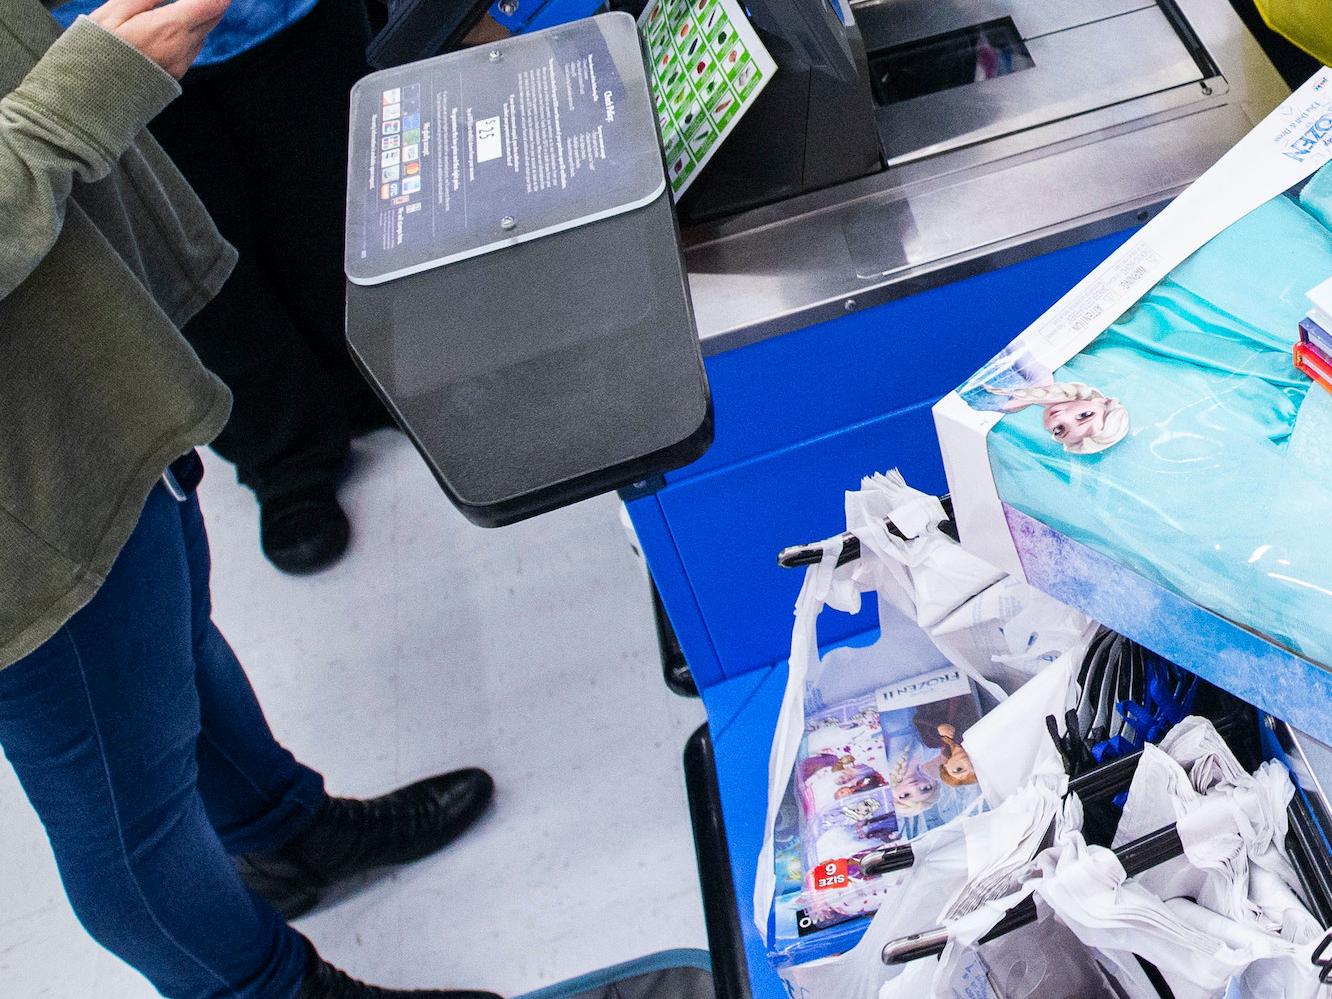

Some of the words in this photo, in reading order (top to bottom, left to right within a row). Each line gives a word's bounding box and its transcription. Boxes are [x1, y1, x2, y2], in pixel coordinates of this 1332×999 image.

[1294, 111, 1309, 124] Doll
[1274, 127, 1293, 144] Dress
[896, 670, 961, 698] FROZEN
[881, 690, 896, 702] II
[825, 862, 838, 876] 6
[818, 874, 846, 888] SIZE
